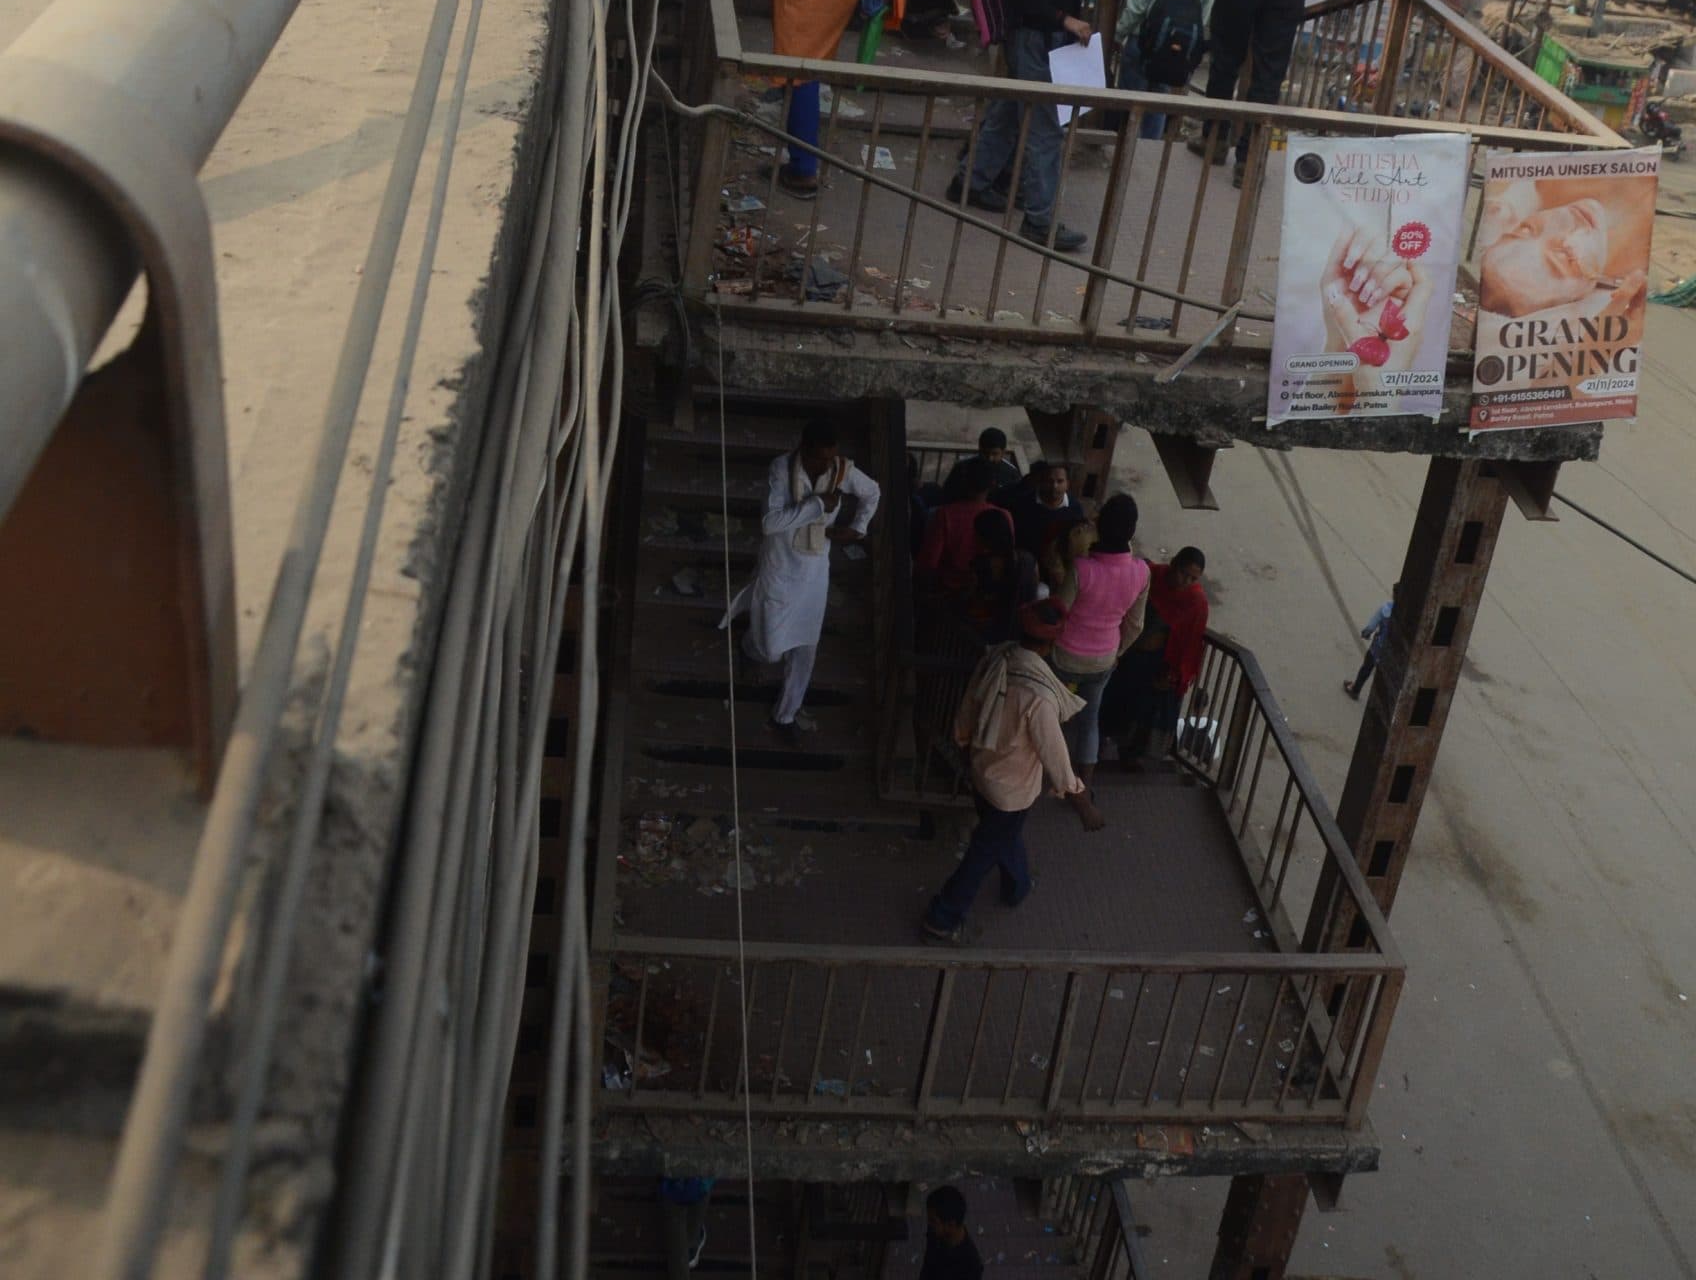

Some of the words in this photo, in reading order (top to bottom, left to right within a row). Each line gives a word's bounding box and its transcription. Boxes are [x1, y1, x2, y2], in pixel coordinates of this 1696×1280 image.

[1334, 152, 1420, 169] MITUSHA
[1320, 167, 1369, 185] Nail
[1374, 165, 1428, 187] Art
[1490, 165, 1555, 180] MITUSHA
[1559, 163, 1607, 177] UNISEX
[1610, 161, 1658, 174] SALON
[1400, 231, 1424, 241] 50%
[1399, 240, 1423, 251] OFF
[1499, 315, 1629, 350] GRAND
[1289, 360, 1317, 369] GRAND
[1318, 359, 1354, 368] OPENING
[1385, 373, 1439, 385] 21/11/2024
[1586, 378, 1635, 391] 21/11/2024
